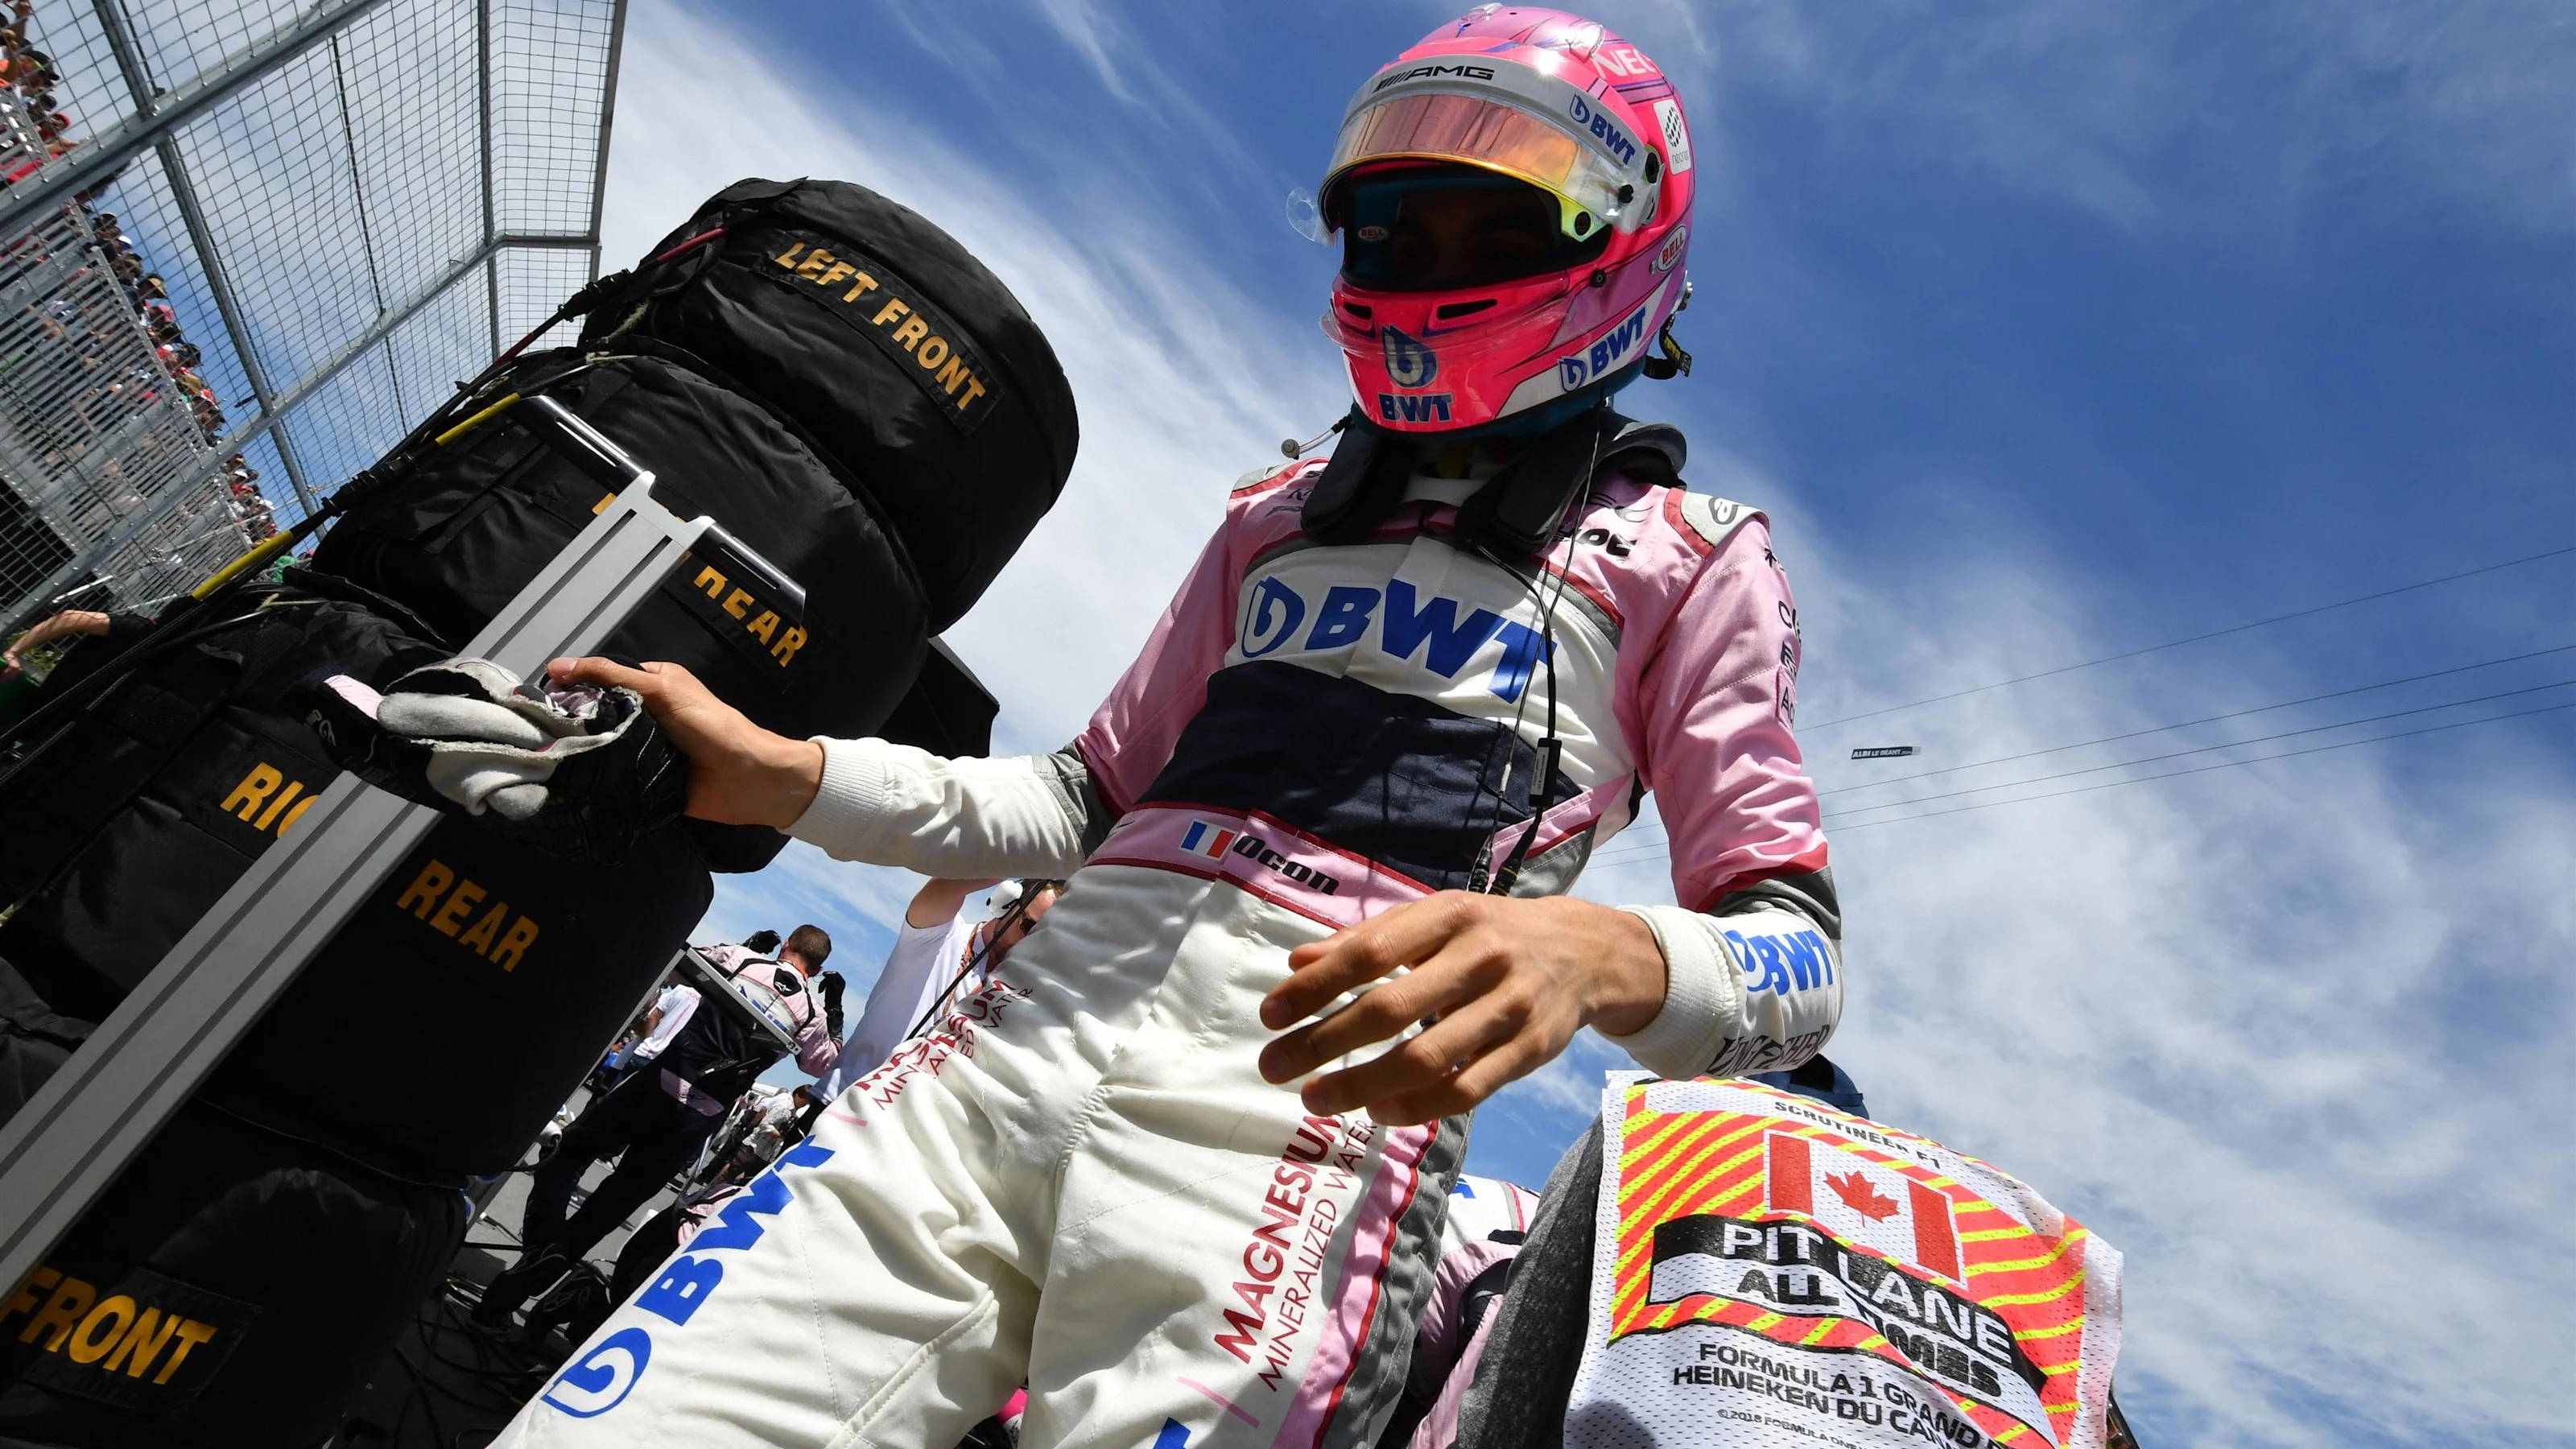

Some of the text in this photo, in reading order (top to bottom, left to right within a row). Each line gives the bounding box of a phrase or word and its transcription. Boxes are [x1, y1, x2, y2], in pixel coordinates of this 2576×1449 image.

[1406, 65, 1495, 81] AMG
[1589, 113, 1636, 166] BWT
[1662, 231, 1684, 265] BELL
[774, 240, 987, 412] LEFT FRONT
[1591, 307, 1647, 378] BWT
[1378, 393, 1454, 423] BWT
[1303, 578, 1558, 704] BWT
[1232, 835, 1340, 896] Ocon
[397, 859, 540, 972] REAR
[1746, 929, 1833, 997] BWT
[1773, 1100, 1941, 1170] SCRUTINEER F1
[633, 1133, 836, 1327] BWT
[1213, 1113, 1346, 1364] MAGNESIUM
[1257, 1118, 1377, 1393] MINERALIZED WATER
[1722, 1222, 2012, 1361] PIT LANE
[1736, 1269, 1840, 1307] ALL
[0, 1265, 219, 1385] FRONT
[1673, 1365, 1829, 1414] HEINEKEN
[1837, 1397, 1882, 1426] DU
[1699, 1343, 1855, 1394] FORMULA
[1883, 1381, 1980, 1448] GRAND
